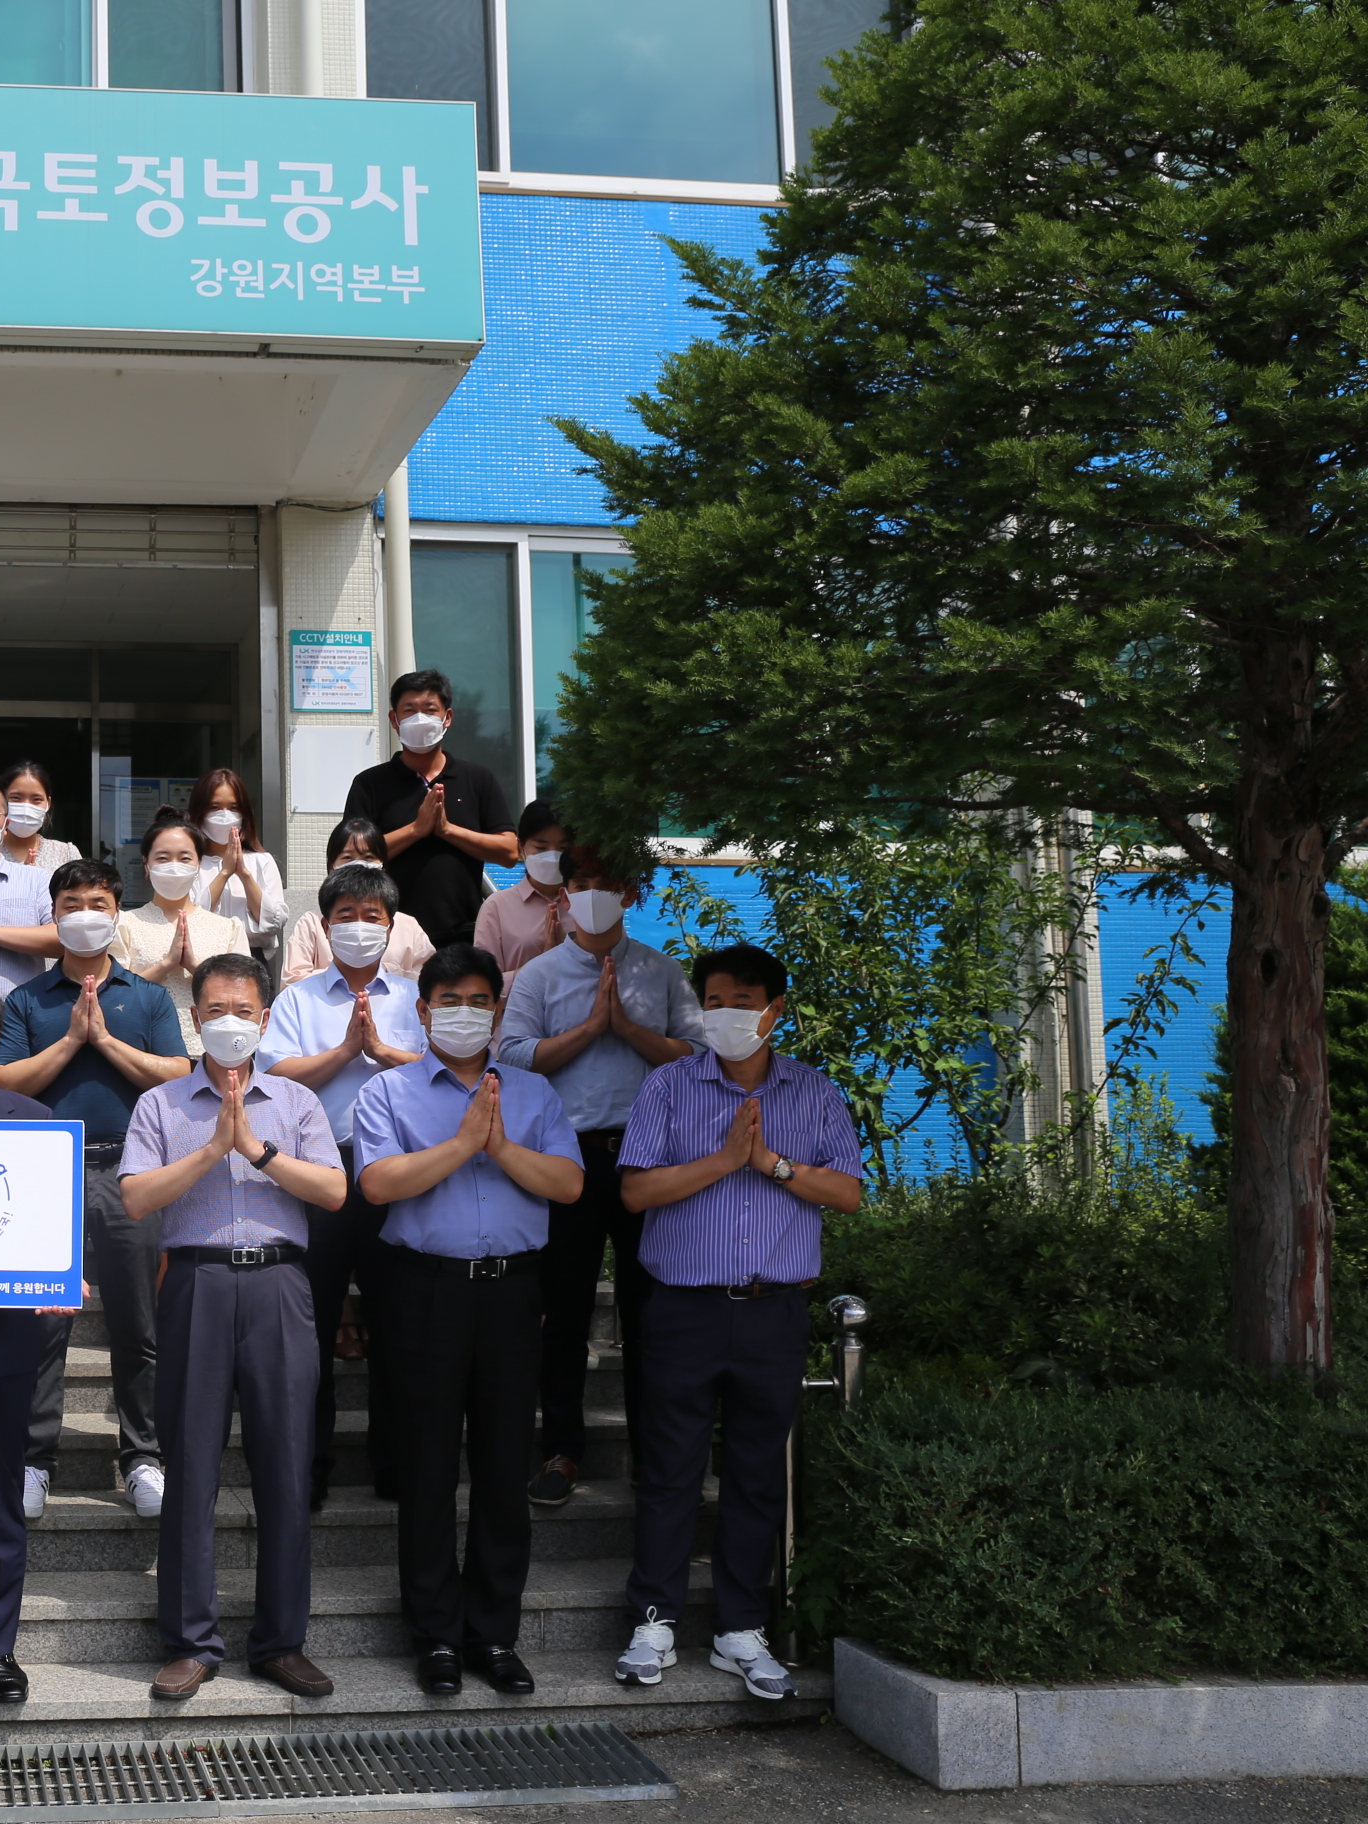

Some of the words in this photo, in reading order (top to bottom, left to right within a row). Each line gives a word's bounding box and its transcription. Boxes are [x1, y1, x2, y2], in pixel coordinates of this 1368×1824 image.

[189, 257, 426, 304] 강원지역본부
[299, 633, 363, 644] CCTV설치안내
[12, 1282, 66, 1295] 응원합니다
